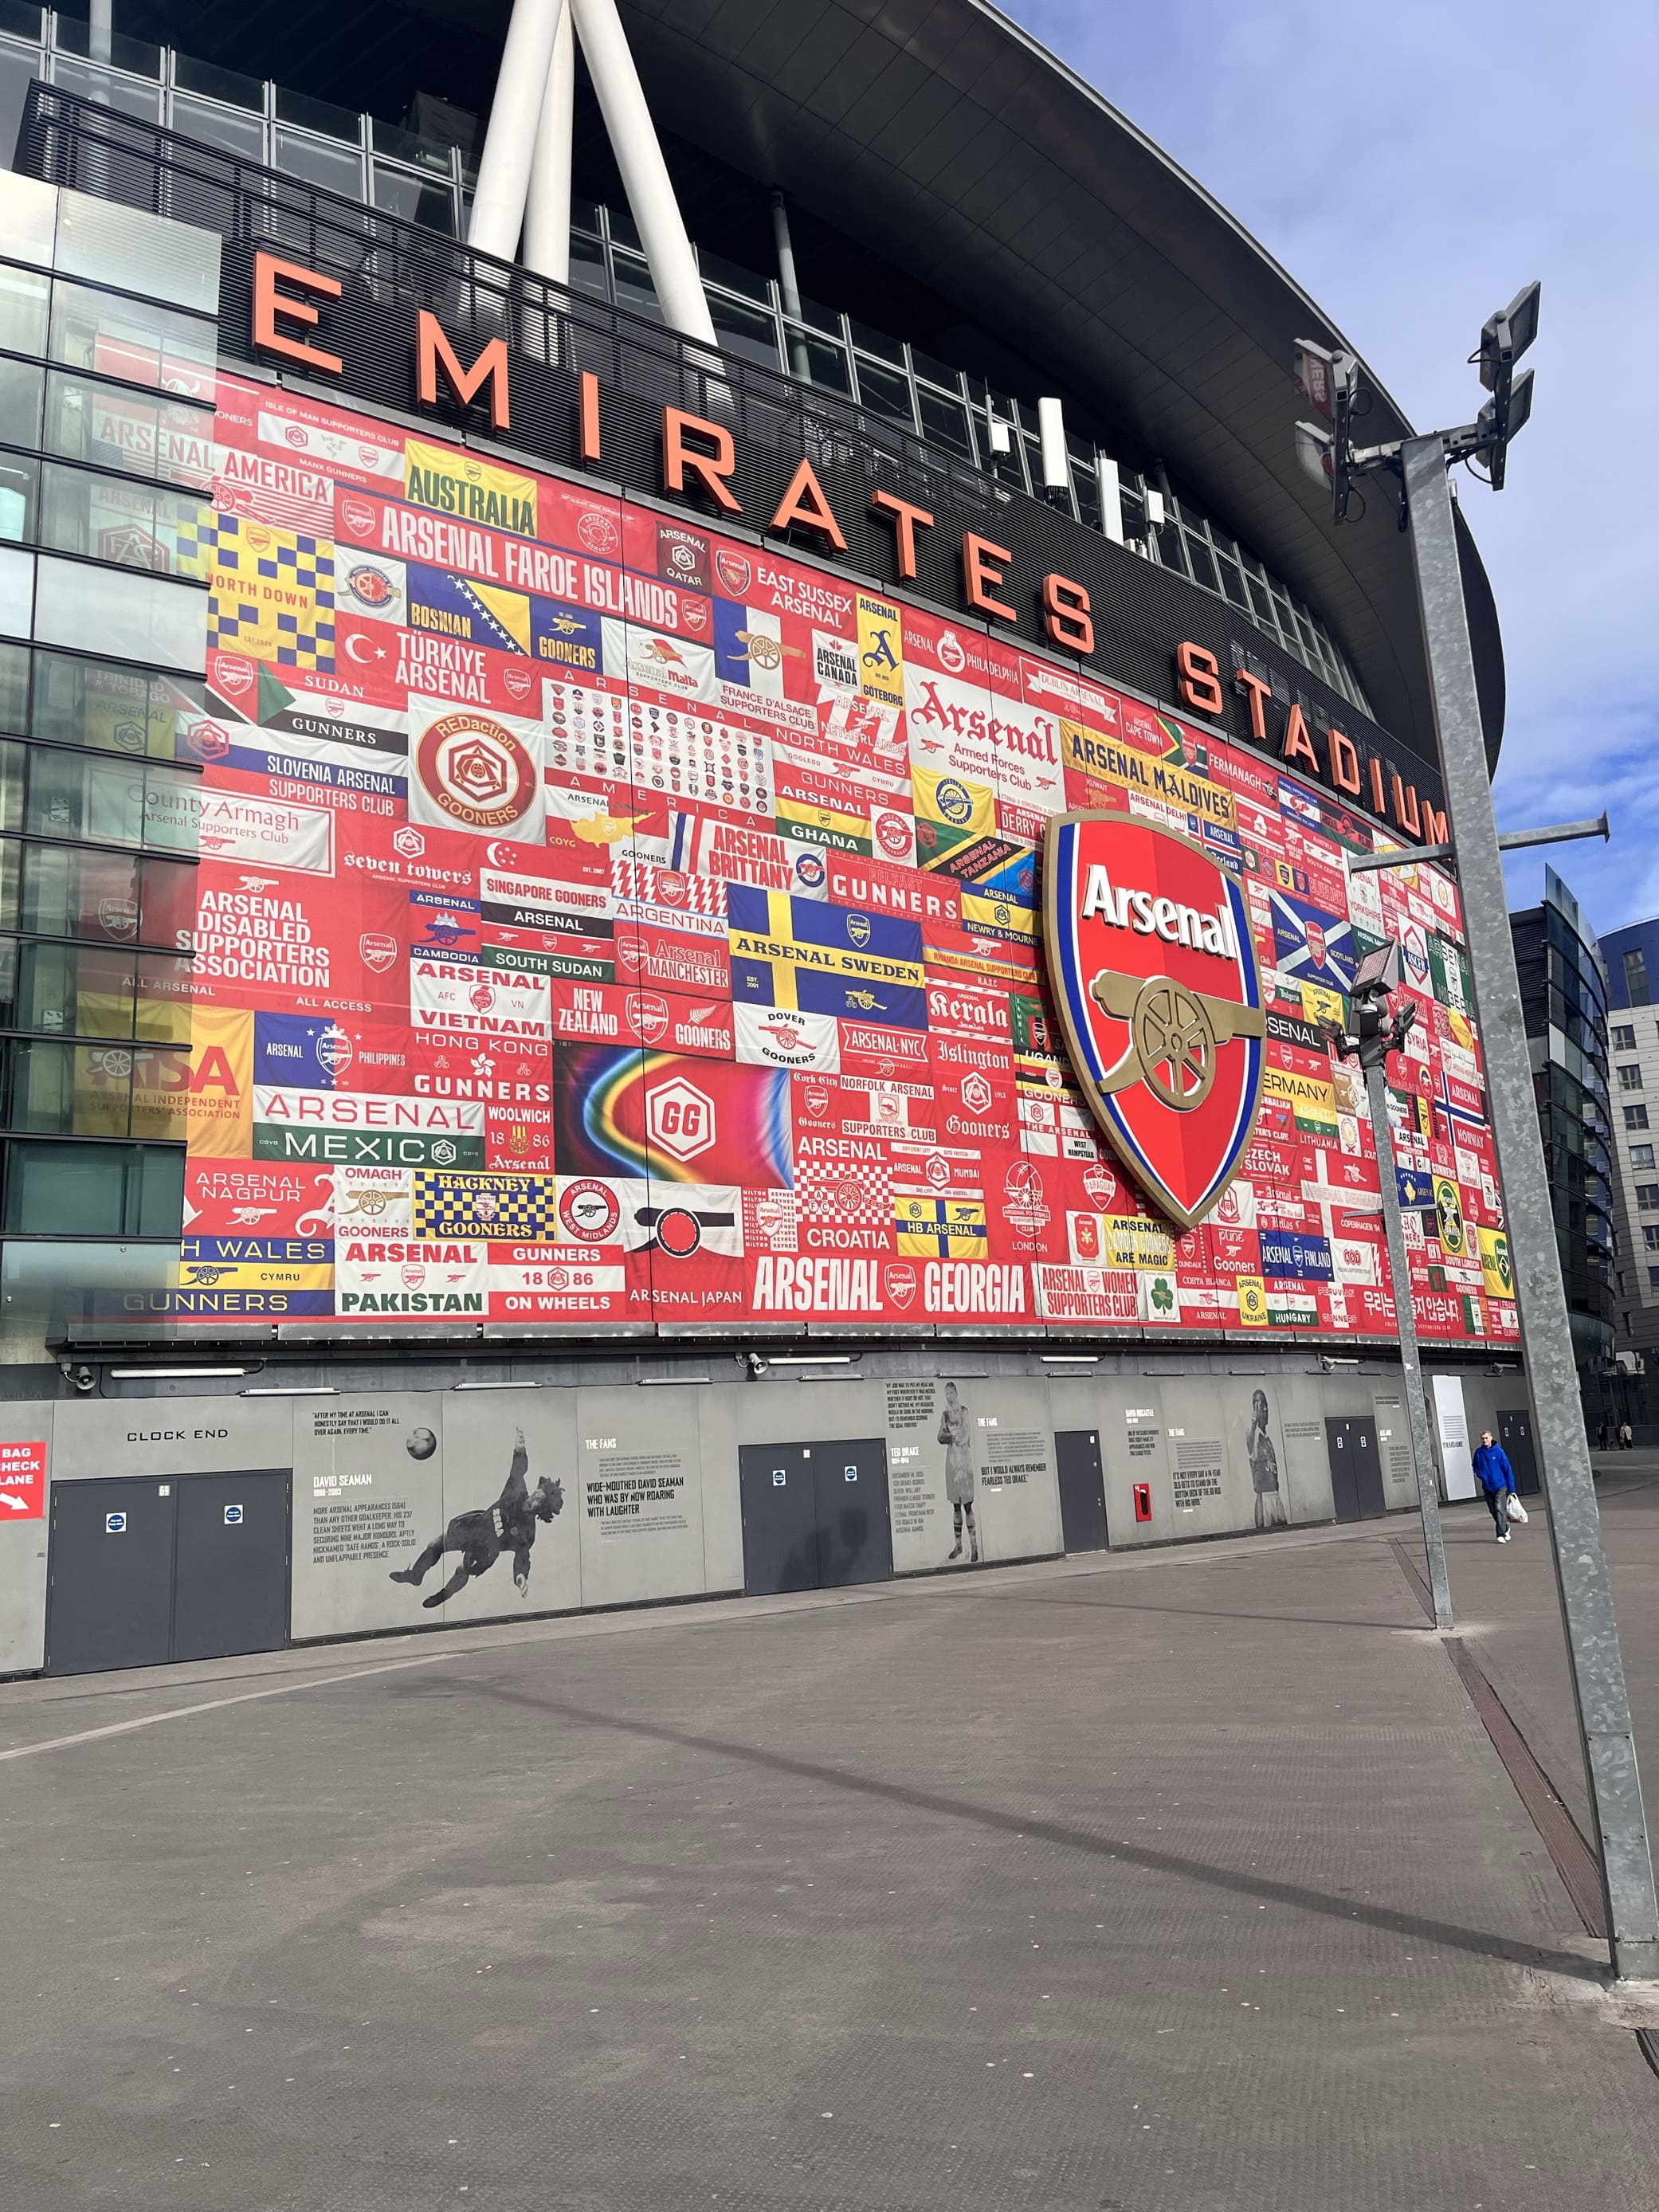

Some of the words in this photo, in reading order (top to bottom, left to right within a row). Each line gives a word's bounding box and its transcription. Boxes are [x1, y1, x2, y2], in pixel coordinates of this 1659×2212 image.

[265, 401, 284, 411] ISLE
[300, 411, 319, 422] MAN
[320, 418, 376, 440] SUPPORTERS
[378, 435, 399, 446] CLUB
[300, 458, 324, 471] MANX
[327, 468, 367, 483] GUNNERS
[407, 465, 535, 536] AUSTRALIA
[660, 529, 706, 553] ARSENAL
[253, 251, 1094, 655] EMIRATES
[1178, 641, 1451, 861] STADIUM
[382, 506, 498, 578] ARSENAL
[505, 542, 578, 599] FAROE
[584, 564, 678, 629] ISLANDS
[666, 567, 702, 586] QATAR
[757, 567, 794, 592] EAST
[798, 582, 853, 614] SUSSEX
[411, 602, 472, 638] BOSNIAN
[771, 594, 842, 629] ARSENAL
[859, 598, 898, 622] ARSENAL
[397, 630, 486, 677] TÜRKİYE
[539, 636, 595, 669] GOONERS
[817, 647, 857, 673] ARSENAL
[904, 629, 935, 654] ARSENAL
[967, 653, 1019, 684] PHILADELPHIA
[395, 659, 491, 704] ARSENAL
[818, 662, 857, 686] CANADA
[305, 676, 364, 698] SUDAN
[863, 684, 903, 706] GÖTEBORG
[720, 696, 786, 722] SUPPORTERS
[789, 715, 814, 730] CLUB
[723, 685, 763, 704] FRANCE
[766, 696, 811, 718] D'ALSACE
[292, 718, 377, 744] GUNNERS
[436, 716, 516, 752] REDaction
[911, 680, 1058, 766] Arsenal
[1125, 723, 1143, 739] CAPE
[1143, 730, 1163, 747] TOWN
[1134, 717, 1153, 730] ARSENAL
[954, 742, 988, 763] Armed
[991, 754, 1026, 775] Forces
[1209, 753, 1261, 789] FERMANAGH
[267, 755, 332, 783] SLOVENIA
[337, 769, 395, 794] ARSENAL
[948, 755, 1007, 782] Supporters
[1010, 774, 1032, 790] Club
[1073, 734, 1149, 786] ARSENAL
[1153, 766, 1230, 819] MALDIVES
[127, 784, 210, 817] County
[214, 802, 300, 831] Armagh
[269, 779, 357, 810] SUPPORTERS
[362, 795, 394, 816] CLUB
[437, 793, 518, 826] GOONERS
[139, 813, 186, 827] Arsenal
[191, 818, 257, 838] Supporters
[261, 830, 288, 844] Club
[343, 850, 400, 873] seven
[407, 862, 473, 885] towers
[487, 878, 552, 900] SINGAPORE
[555, 888, 606, 908] GOONERS
[984, 888, 1018, 904] ARSENAL
[201, 890, 308, 923] ARSENAL
[616, 903, 724, 935] ARGENTINA
[1082, 864, 1237, 961] Arsenal
[1350, 898, 1381, 923] YORKSHIRE
[198, 912, 311, 943] DISABLED
[514, 911, 583, 931] ARSENAL
[967, 921, 996, 935] NEWRY
[998, 928, 1003, 938] &
[1005, 931, 1038, 946] MOURNE
[176, 929, 330, 967] SUPPORTERS
[736, 938, 836, 967] ARSENAL
[841, 956, 919, 981] SWEDEN
[175, 954, 330, 988] ASSOCIATION
[417, 963, 545, 990] ARSENAL
[496, 952, 547, 971] SOUTH
[552, 961, 602, 978] SUDAN
[296, 997, 319, 1007] ALL
[323, 999, 372, 1013] ACCESS
[437, 991, 456, 1001] AFC
[512, 1000, 524, 1009] VN
[573, 987, 603, 1013] NEW
[418, 1010, 544, 1036] VIETNAM
[559, 1009, 618, 1037] ZEALAND
[415, 1032, 479, 1050] HONG
[489, 1041, 548, 1057] KONG
[676, 1023, 731, 1050] GOONERS
[266, 1042, 303, 1058] ARSENAL
[359, 1051, 406, 1067] PHILIPPINES
[937, 1039, 1010, 1070] Islington
[414, 1074, 550, 1102] GUNNERS
[1451, 1084, 1479, 1107] ARSENAL
[488, 1106, 550, 1123] WOOLWICH
[661, 1101, 701, 1136] GG
[491, 1131, 505, 1145] 18
[533, 1133, 550, 1147] 86
[798, 1136, 887, 1161] ARSENAL
[1457, 1128, 1484, 1149] NORWAY
[489, 1155, 550, 1171] Arsenal
[438, 1175, 531, 1192] HACKNEY
[570, 1183, 608, 1197] ARSENAL
[439, 1222, 533, 1237] GOONERS
[563, 1210, 580, 1234] WEST
[581, 1211, 618, 1240] MIDLANDS
[807, 1228, 890, 1249] CROATIA
[1012, 1241, 1048, 1252] LONDON
[345, 1243, 477, 1264] ARSENAL
[513, 1249, 601, 1262] GUNNERS
[1214, 1256, 1256, 1273] Gooners
[1262, 1245, 1292, 1265] ARSENAL
[1304, 1250, 1331, 1268] FINLAND
[523, 1273, 543, 1285] 18
[573, 1273, 594, 1285] 86
[752, 1256, 883, 1311] ARSENAL
[924, 1261, 1026, 1313] GEORGIA
[1042, 1266, 1087, 1292] ARSENAL
[1103, 1270, 1138, 1294] WOMEN
[1182, 1276, 1206, 1284] COSTA
[1207, 1277, 1231, 1287] BLANCA
[1274, 1281, 1306, 1292] ARSENAL
[342, 1292, 482, 1312] PAKISTAN
[505, 1297, 532, 1310] ON
[539, 1296, 611, 1310] WHEELS
[1047, 1292, 1112, 1316] SUPPORTERS
[1113, 1296, 1136, 1317] CLUB
[1276, 1313, 1311, 1324] HUNGARY
[127, 1430, 186, 1441] CLOCK
[194, 1430, 229, 1439] END
[586, 1439, 598, 1449] THE
[599, 1438, 617, 1449] FANS
[2, 1447, 32, 1458] BAG
[891, 1448, 901, 1457] TED
[902, 1446, 919, 1456] DRAKE
[0, 1460, 41, 1472] HECK
[159, 1485, 170, 1496] 69
[313, 1477, 337, 1488] DAVID
[339, 1473, 372, 1486] SEAMAN
[587, 1480, 637, 1492] WIDE-MOUTHED
[638, 1478, 657, 1489] DAVID
[658, 1477, 684, 1488] SEAMAN
[587, 1494, 602, 1504] WHO
[604, 1493, 618, 1504] WAS
[620, 1492, 629, 1503] BY
[631, 1492, 645, 1501] NOW
[647, 1490, 674, 1500] ROARING
[587, 1507, 604, 1517] WITH
[606, 1504, 640, 1516] LAUGHTER
